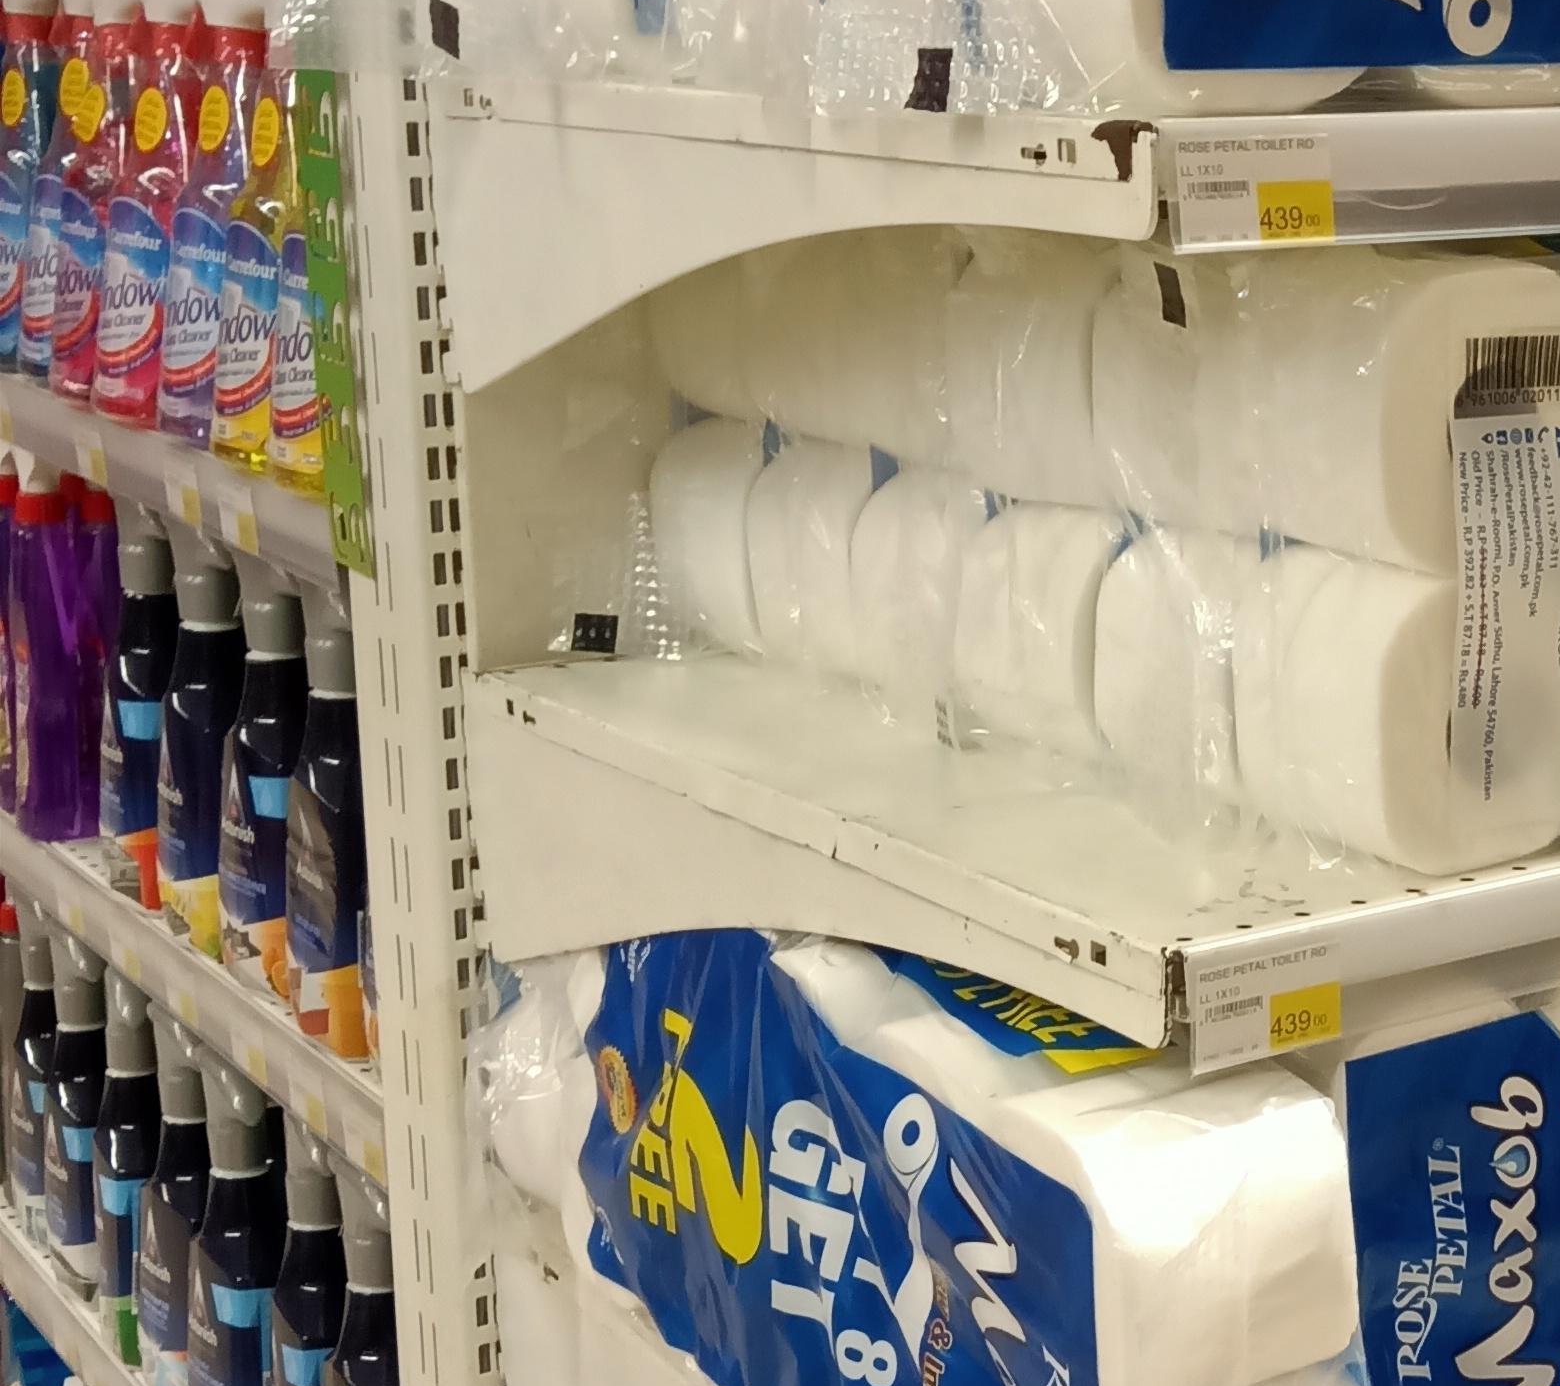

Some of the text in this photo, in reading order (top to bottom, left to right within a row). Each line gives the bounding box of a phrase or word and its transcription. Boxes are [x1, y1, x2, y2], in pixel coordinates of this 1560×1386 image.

[1178, 137, 1315, 154] ROSE PETAL TOILET RO
[1180, 164, 1224, 177] LL 1X10
[1259, 205, 1320, 231] 439 00
[101, 272, 162, 311] ndow
[219, 303, 277, 345] ndow
[1459, 452, 1467, 479] New
[1471, 450, 1482, 473] Old
[1460, 482, 1471, 513] Price
[1473, 475, 1486, 507] Price
[1514, 447, 1534, 590] www.rosepetal.com.pk
[1464, 549, 1475, 590] 392.82
[1487, 666, 1502, 707] Lahore
[1483, 749, 1495, 801] Pakistan
[1200, 945, 1327, 983] ROSE PETAL TOILET RO
[1200, 986, 1241, 1005] LL 1X10
[1270, 1009, 1328, 1037] 439 00
[1394, 1144, 1469, 1384] ROSE PETAL
